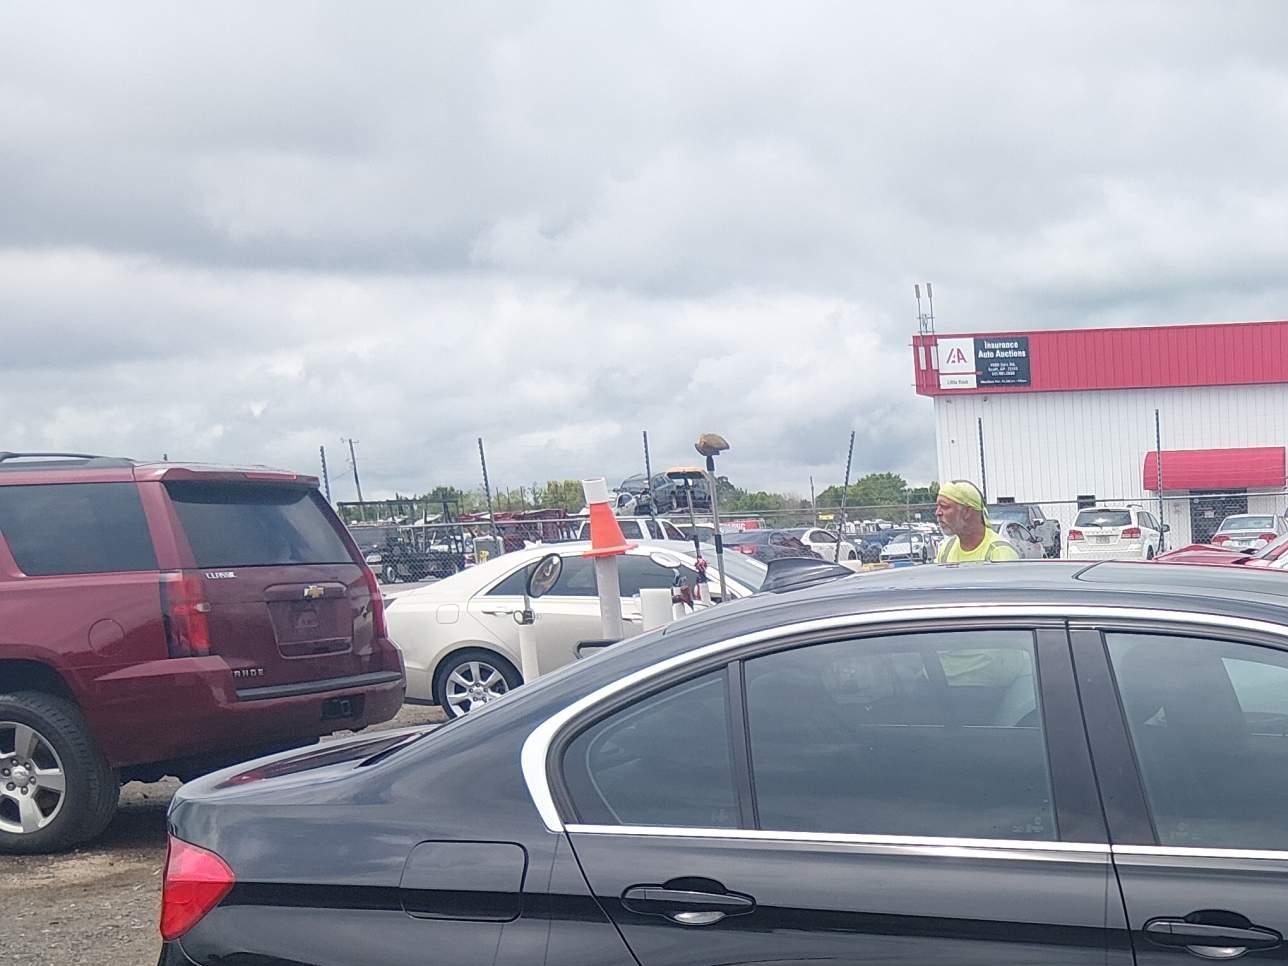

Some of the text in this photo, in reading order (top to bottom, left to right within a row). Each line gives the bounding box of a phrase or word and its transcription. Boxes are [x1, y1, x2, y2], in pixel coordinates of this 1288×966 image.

[984, 340, 1019, 349] Insurance
[978, 349, 1026, 358] Auto Auctions
